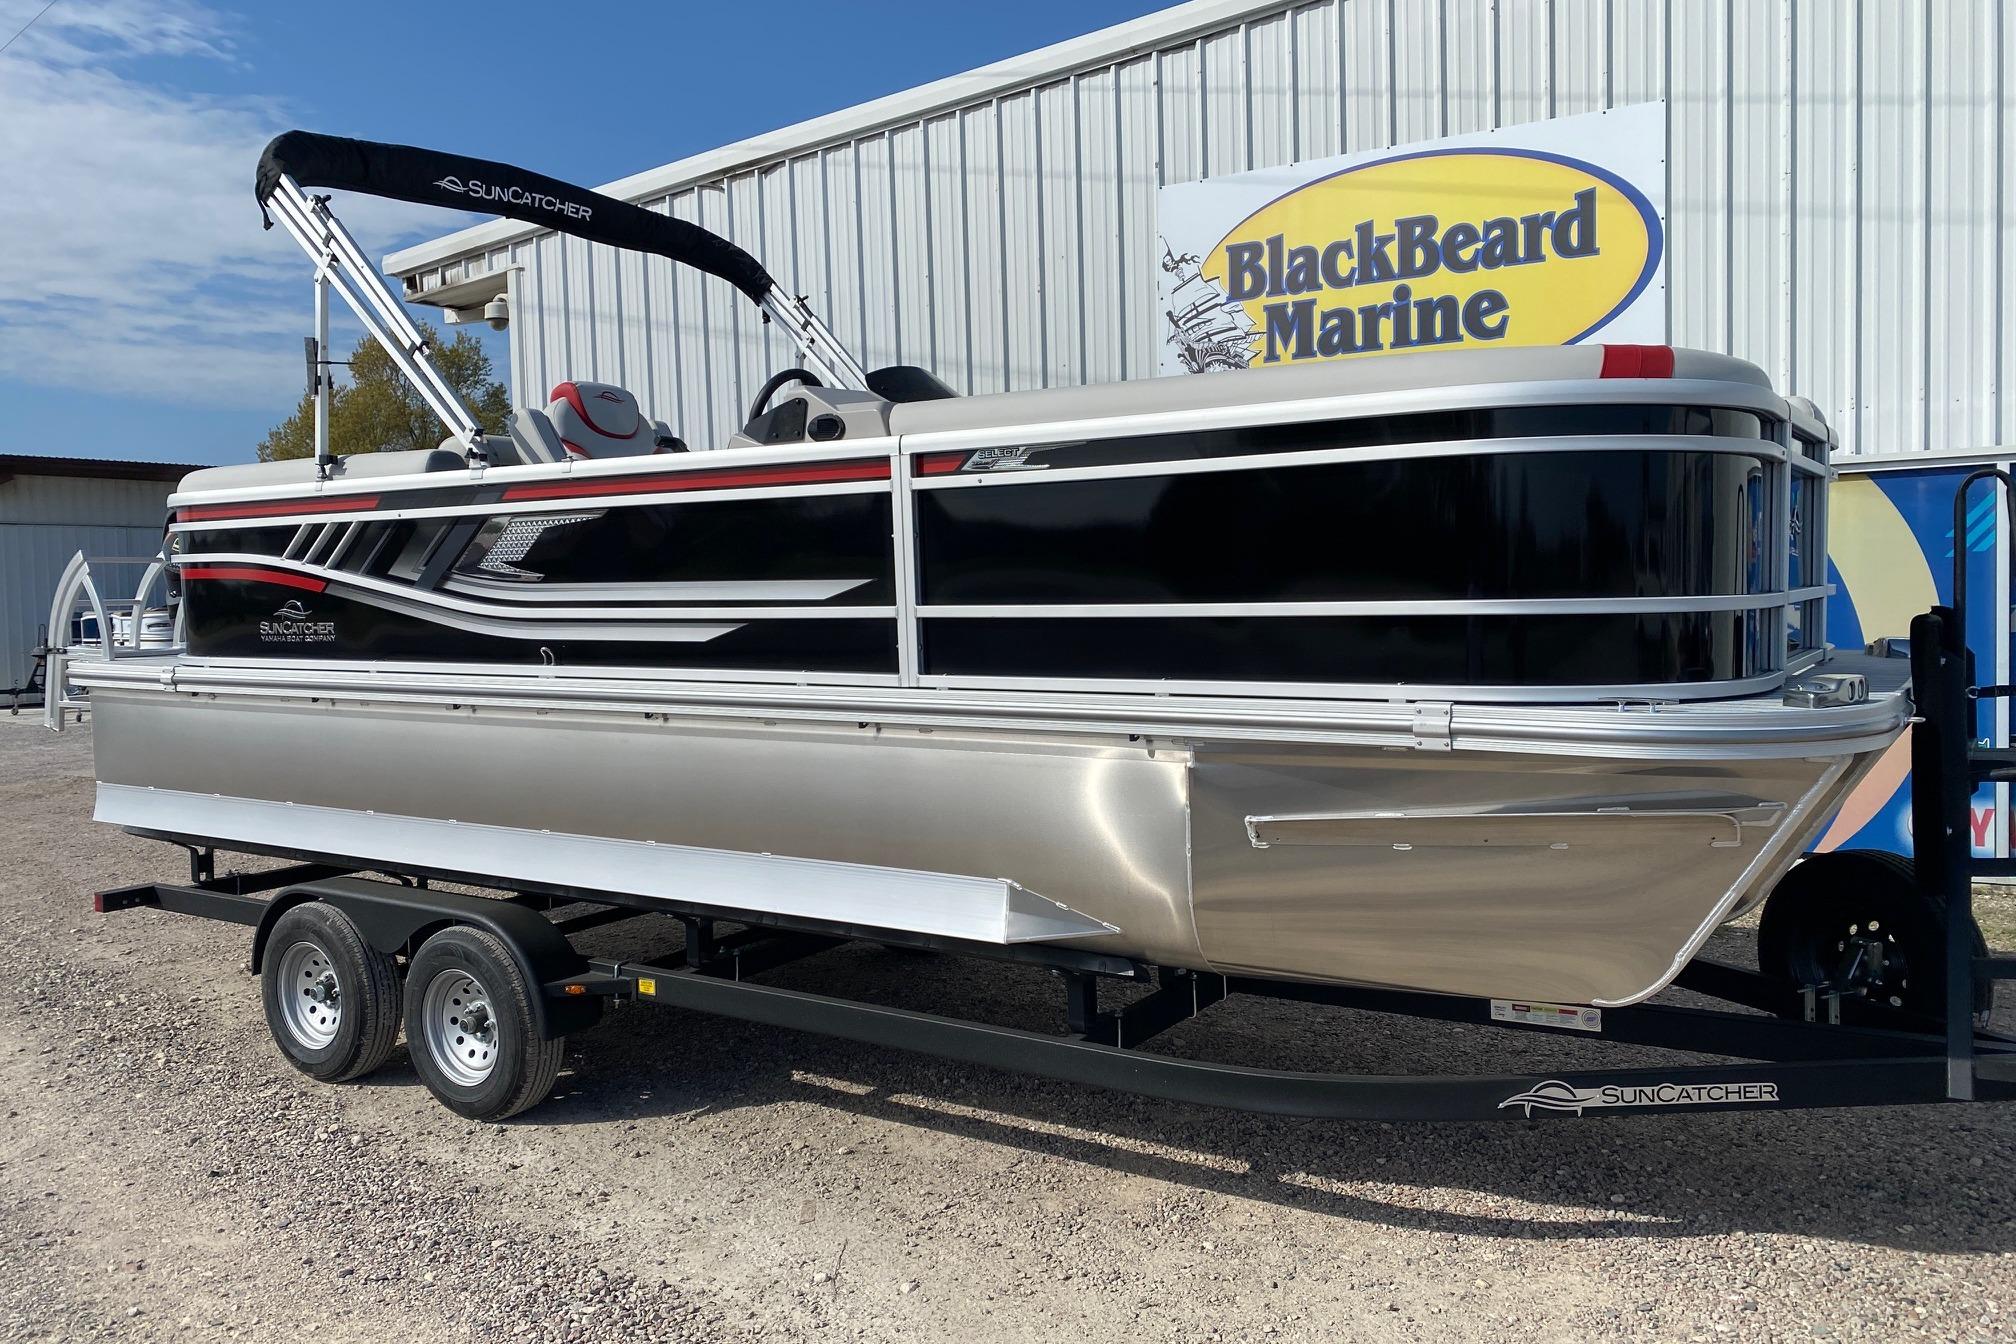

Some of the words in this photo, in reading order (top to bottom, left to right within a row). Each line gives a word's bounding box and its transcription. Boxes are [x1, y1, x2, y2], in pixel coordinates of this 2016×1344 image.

[468, 180, 592, 221] SUNCATCHER
[1226, 187, 1600, 302] BlackBeard
[1263, 284, 1509, 364] Marine
[978, 448, 1019, 459] SELECT
[260, 621, 334, 635] SUNCATCHER
[1601, 1085, 1777, 1104] SUNCATCHER
